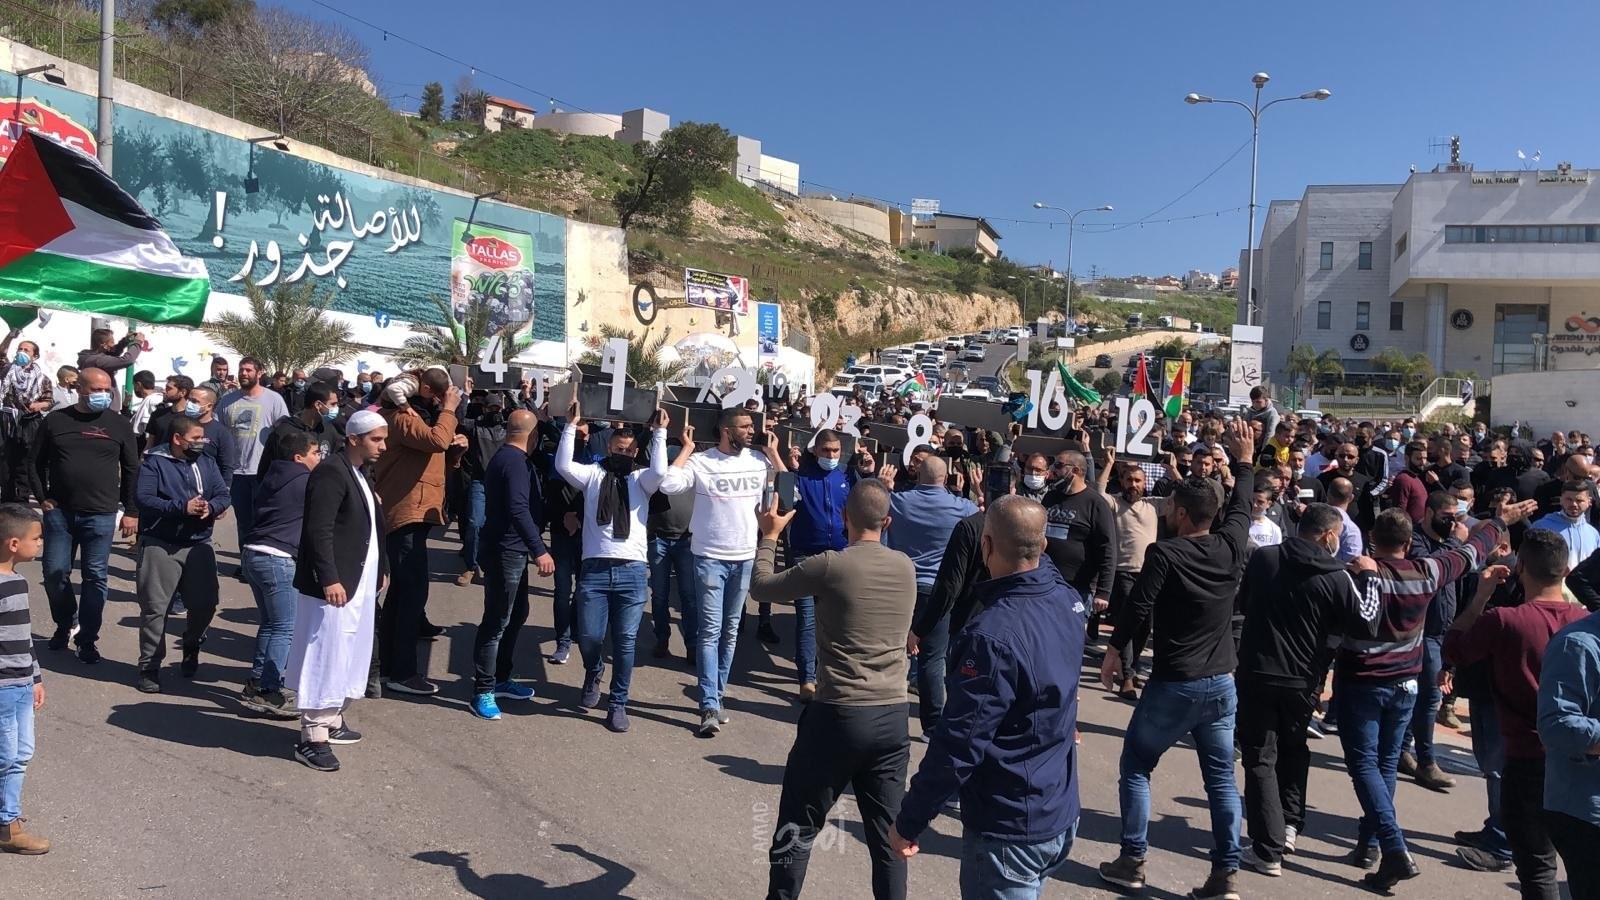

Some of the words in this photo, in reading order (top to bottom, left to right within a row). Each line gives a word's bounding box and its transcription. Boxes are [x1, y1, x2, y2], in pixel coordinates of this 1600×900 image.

[227, 233, 354, 289] جذور
[471, 243, 518, 261] TALLAS
[480, 336, 508, 384] 4
[768, 372, 788, 399] 19
[1027, 369, 1068, 431] 16
[1113, 397, 1156, 456] 12
[1046, 508, 1077, 520] OSS
